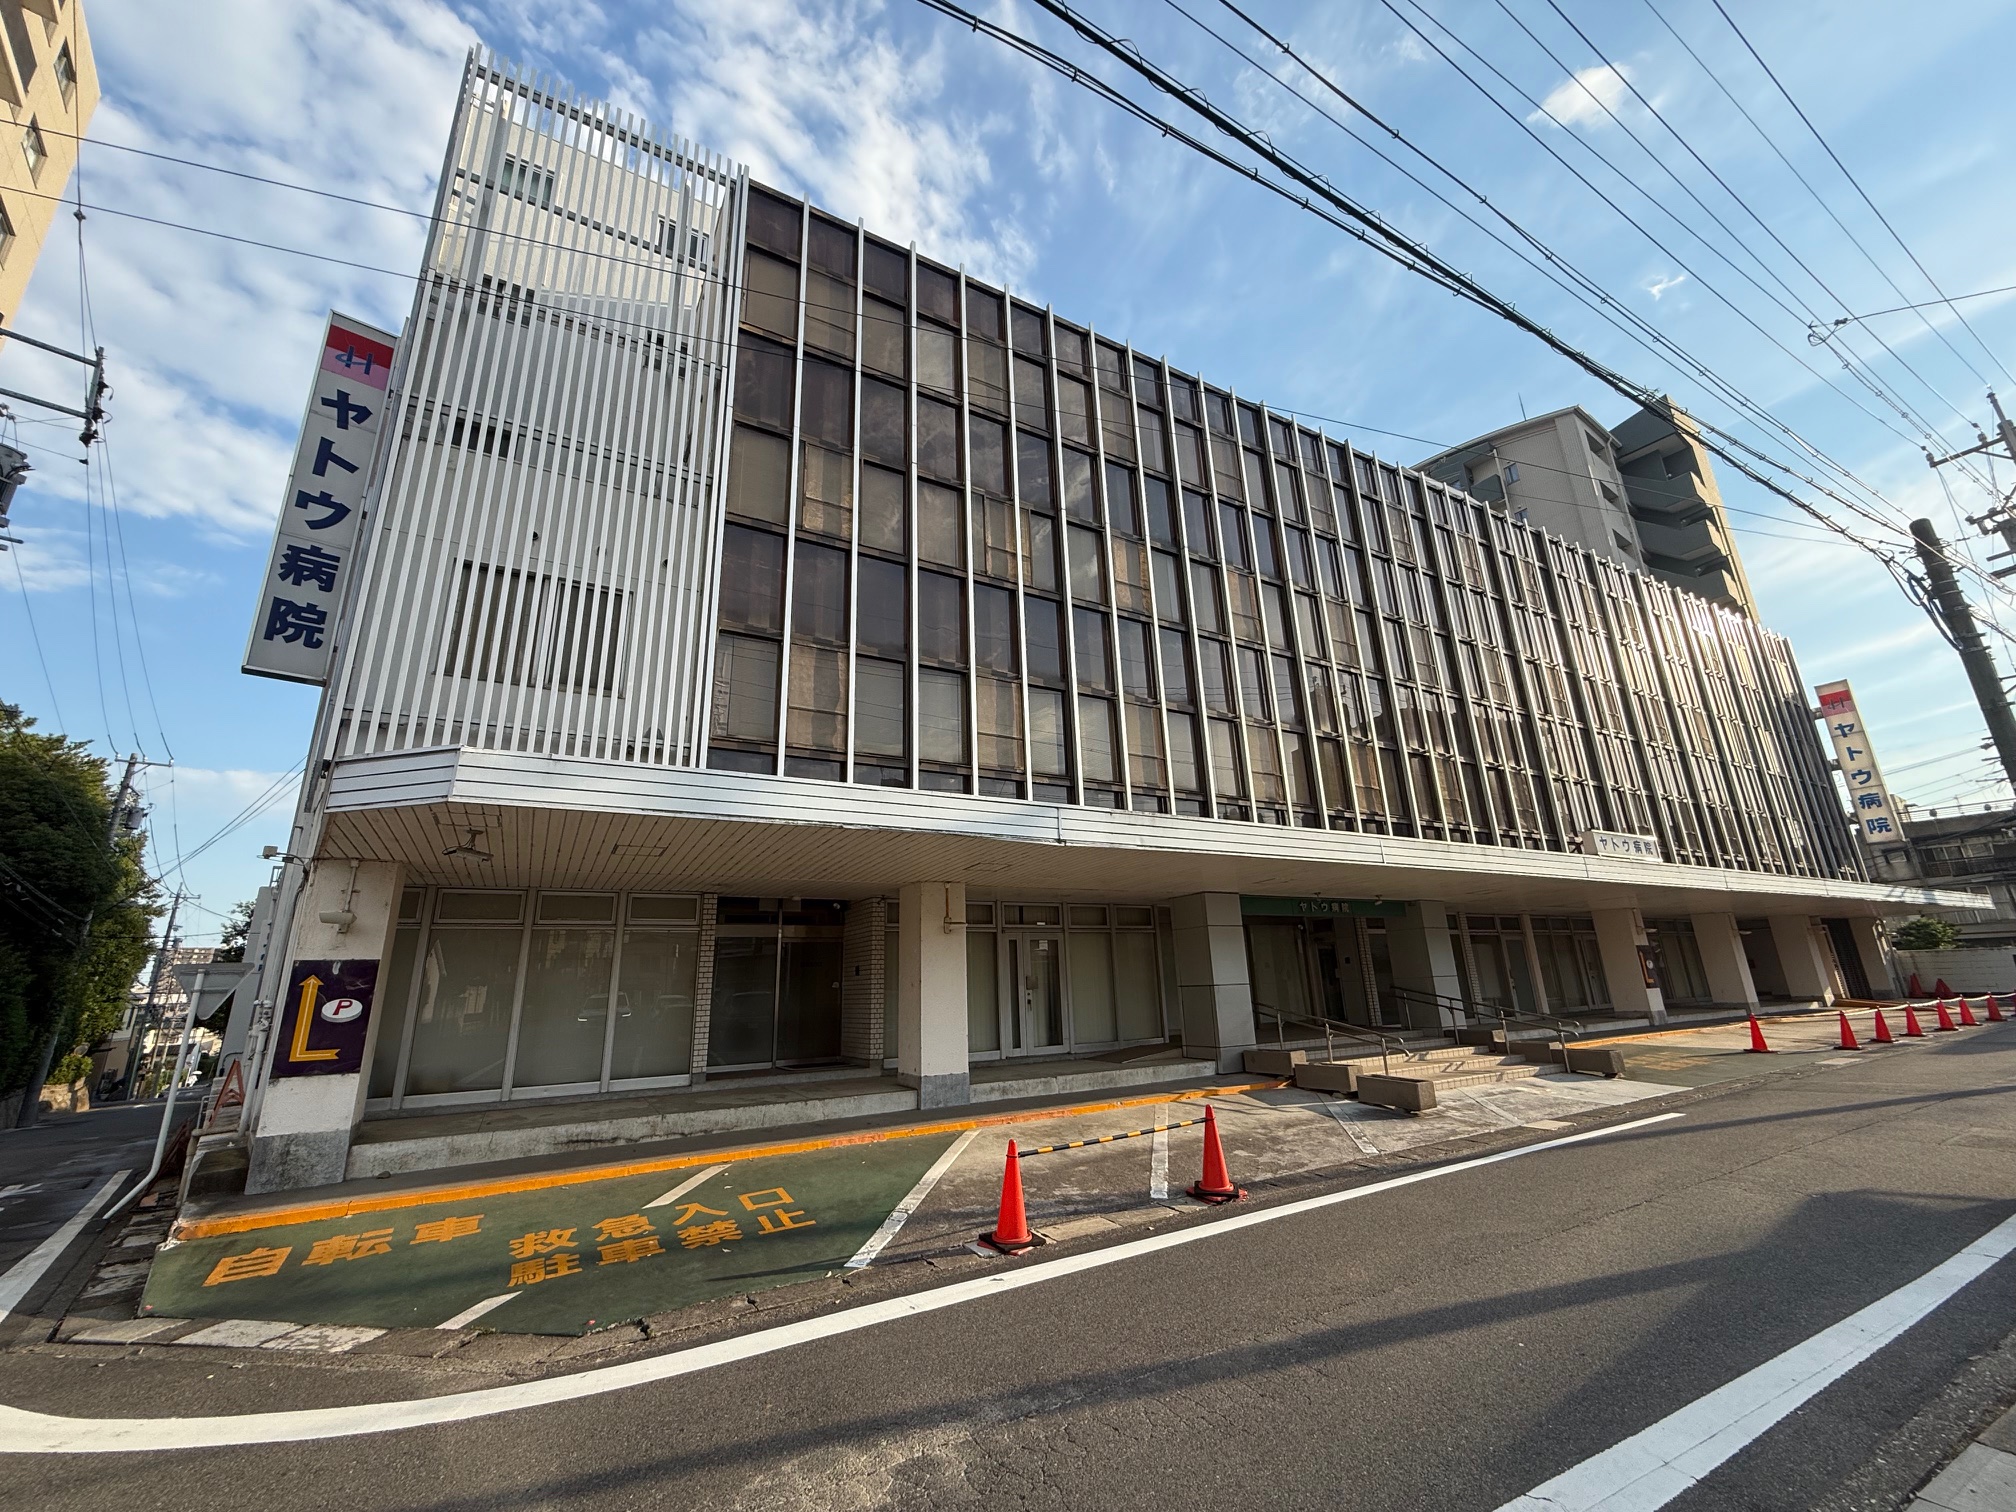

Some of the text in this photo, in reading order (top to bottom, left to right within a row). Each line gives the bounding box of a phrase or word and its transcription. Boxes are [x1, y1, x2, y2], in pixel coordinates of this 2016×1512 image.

[263, 388, 373, 650] ヤトウ病院
[1834, 722, 1893, 835] ヤトウ病院
[1599, 836, 1654, 855] ヤトウ病院
[1299, 901, 1350, 913] ヤトウ病院
[332, 999, 354, 1016] P
[201, 1213, 485, 1287] 自転車
[507, 1208, 817, 1287] 駐車禁止
[509, 1187, 794, 1259] 救急入口
